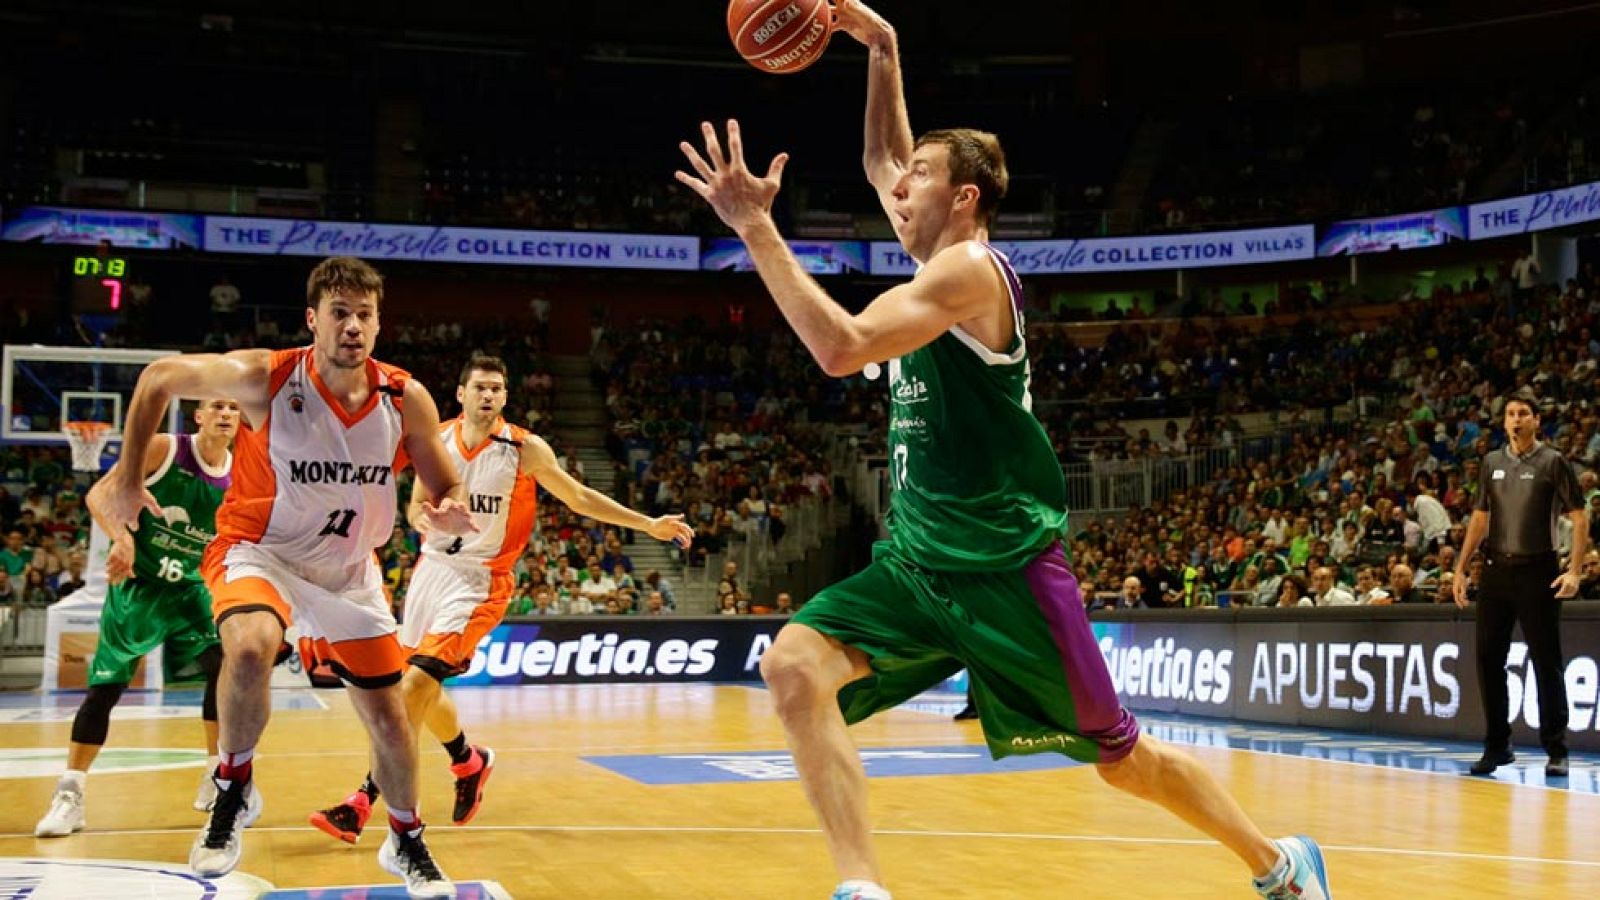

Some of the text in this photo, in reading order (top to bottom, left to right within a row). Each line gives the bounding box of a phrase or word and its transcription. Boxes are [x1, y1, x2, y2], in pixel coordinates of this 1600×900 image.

[764, 18, 824, 69] SPALDING
[1480, 208, 1520, 229] THE
[219, 221, 689, 261] THE Peninsula COLLECTION VILLAS
[882, 251, 913, 267] TH
[1092, 241, 1233, 264] COLLECTION
[1245, 234, 1305, 253] VILLAS
[102, 280, 121, 309] 7
[318, 508, 357, 537] 11
[157, 555, 184, 582] 16
[457, 632, 718, 677] Suertia.es
[1249, 641, 1461, 718] APUESTAS
